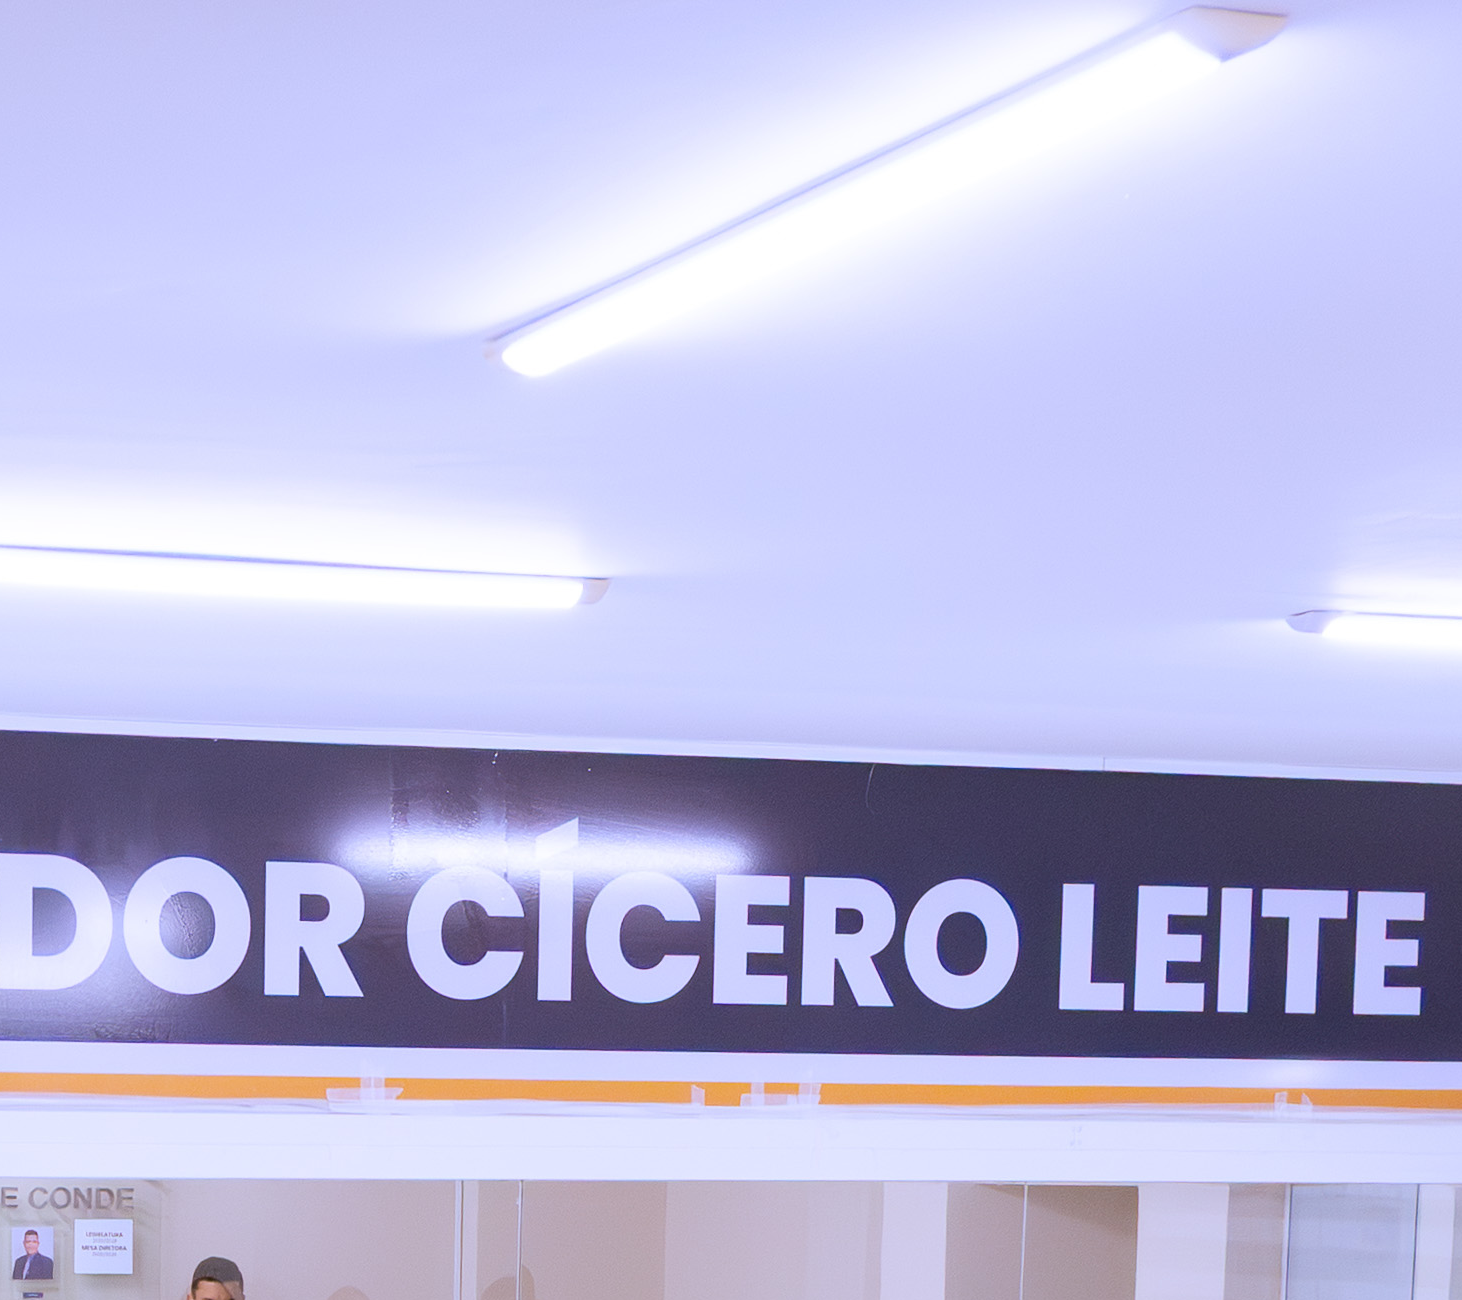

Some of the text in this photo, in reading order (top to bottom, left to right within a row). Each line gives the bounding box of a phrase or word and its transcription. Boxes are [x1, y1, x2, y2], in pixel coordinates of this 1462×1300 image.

[406, 816, 1019, 1009] CÍCERO
[1058, 882, 1427, 1016] LEITE
[28, 1186, 135, 1210] CONDE
